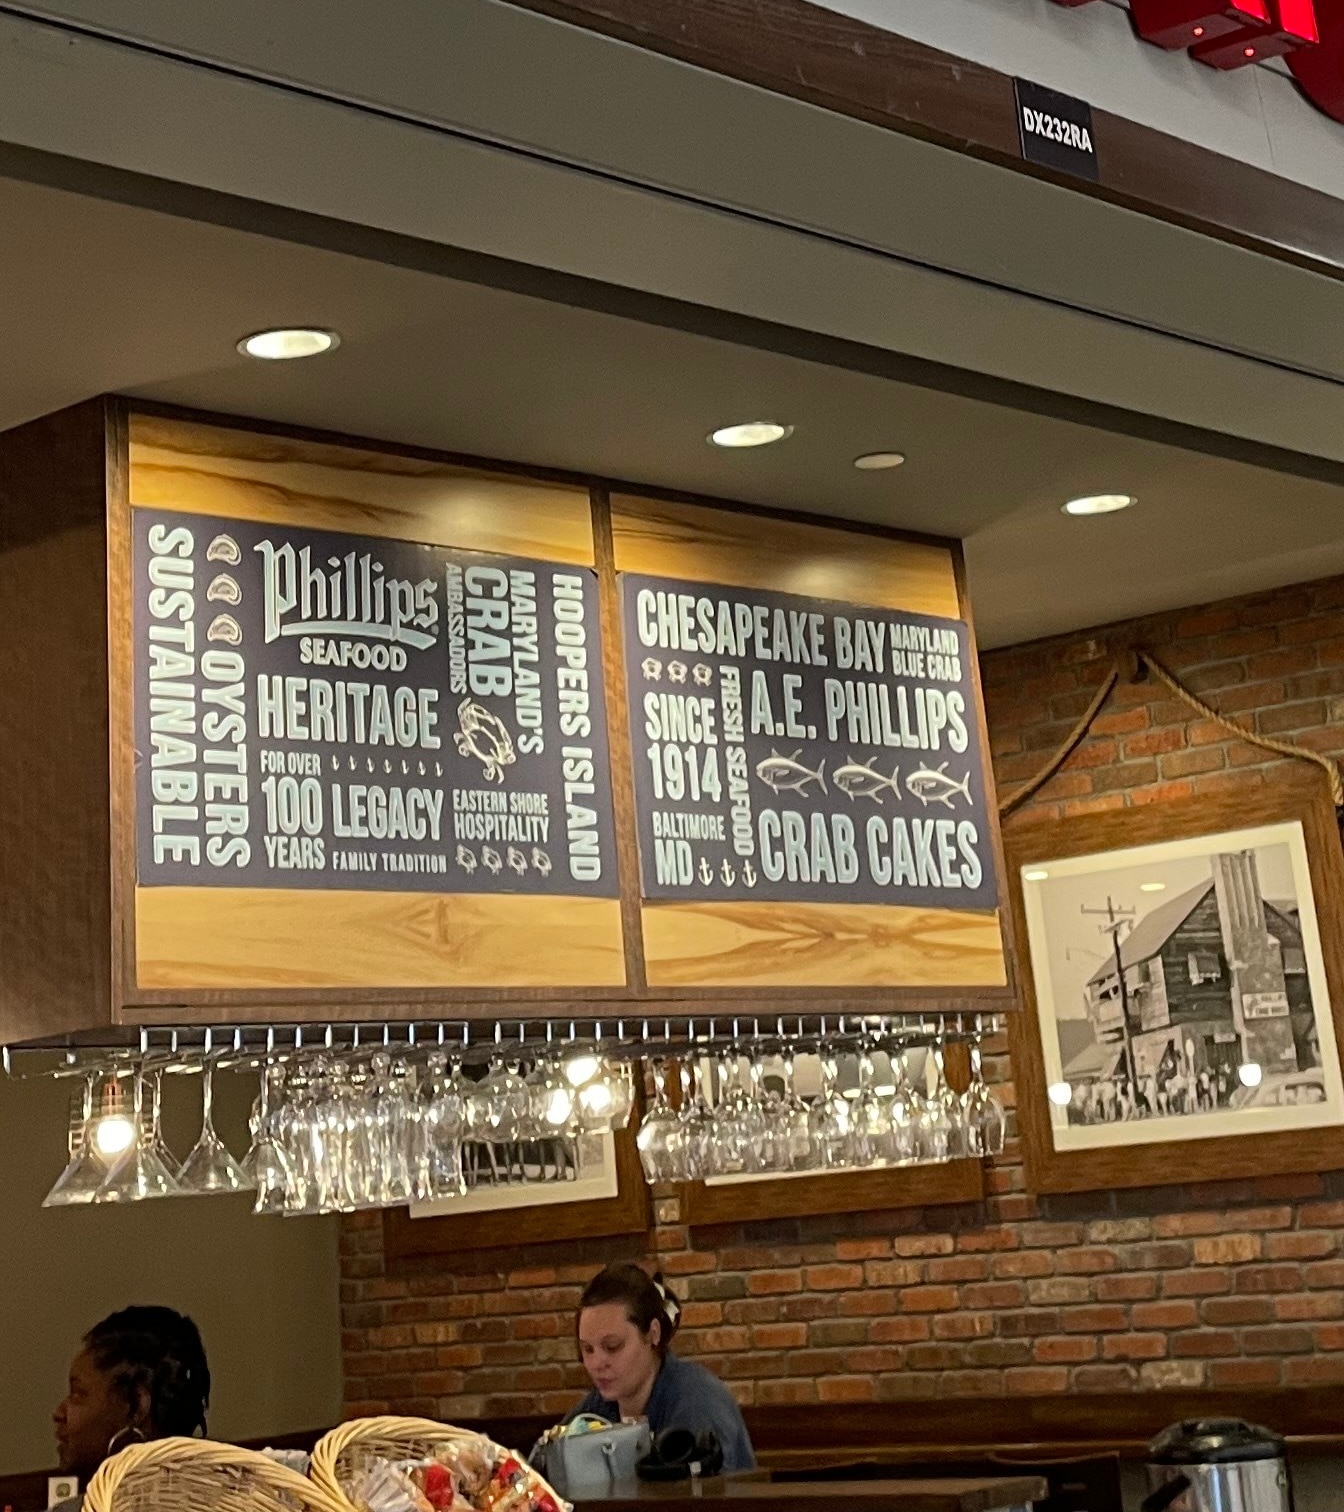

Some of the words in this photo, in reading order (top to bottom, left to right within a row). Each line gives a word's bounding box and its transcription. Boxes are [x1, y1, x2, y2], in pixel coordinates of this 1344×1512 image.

[1022, 105, 1094, 155] DX232RA
[253, 538, 440, 645] Phillips
[299, 636, 408, 673] SEAFOOD
[445, 561, 468, 695] AMBASSADORS
[464, 565, 513, 697] CRAB
[552, 573, 592, 739] HOOPERS
[635, 587, 828, 667] CHESAPEAKE
[833, 616, 886, 675] BAY
[889, 623, 959, 657] MARYLAND
[509, 569, 545, 755] MARYLAND'S
[891, 649, 926, 680] BLUE
[927, 653, 963, 683] CRAB
[148, 523, 201, 866] SUSTAINABLE
[256, 673, 442, 750] HERITAGE
[643, 691, 718, 745] SINCE
[719, 664, 745, 743] FRESH
[749, 670, 817, 740] A.E.
[824, 678, 969, 754] PHILLIPS
[201, 649, 252, 868] OYSTERS
[260, 750, 287, 774] FOR
[287, 752, 322, 777] OVER
[646, 742, 723, 803] 1914
[261, 776, 324, 836] 100
[332, 783, 444, 841] LEGACY
[452, 788, 508, 814] EASTERN
[509, 791, 549, 815] SHORE
[454, 812, 549, 843] HOSPITALITY
[562, 746, 602, 882] ISLAND
[652, 810, 726, 841] BALTIMORE
[724, 744, 755, 857] SEAFOOD
[263, 835, 326, 871] YEARS
[332, 851, 378, 872] FAMILY
[381, 852, 447, 874] TRADITION
[654, 838, 695, 887] MD
[757, 807, 859, 885] CRAB
[865, 814, 983, 890] CAKES
